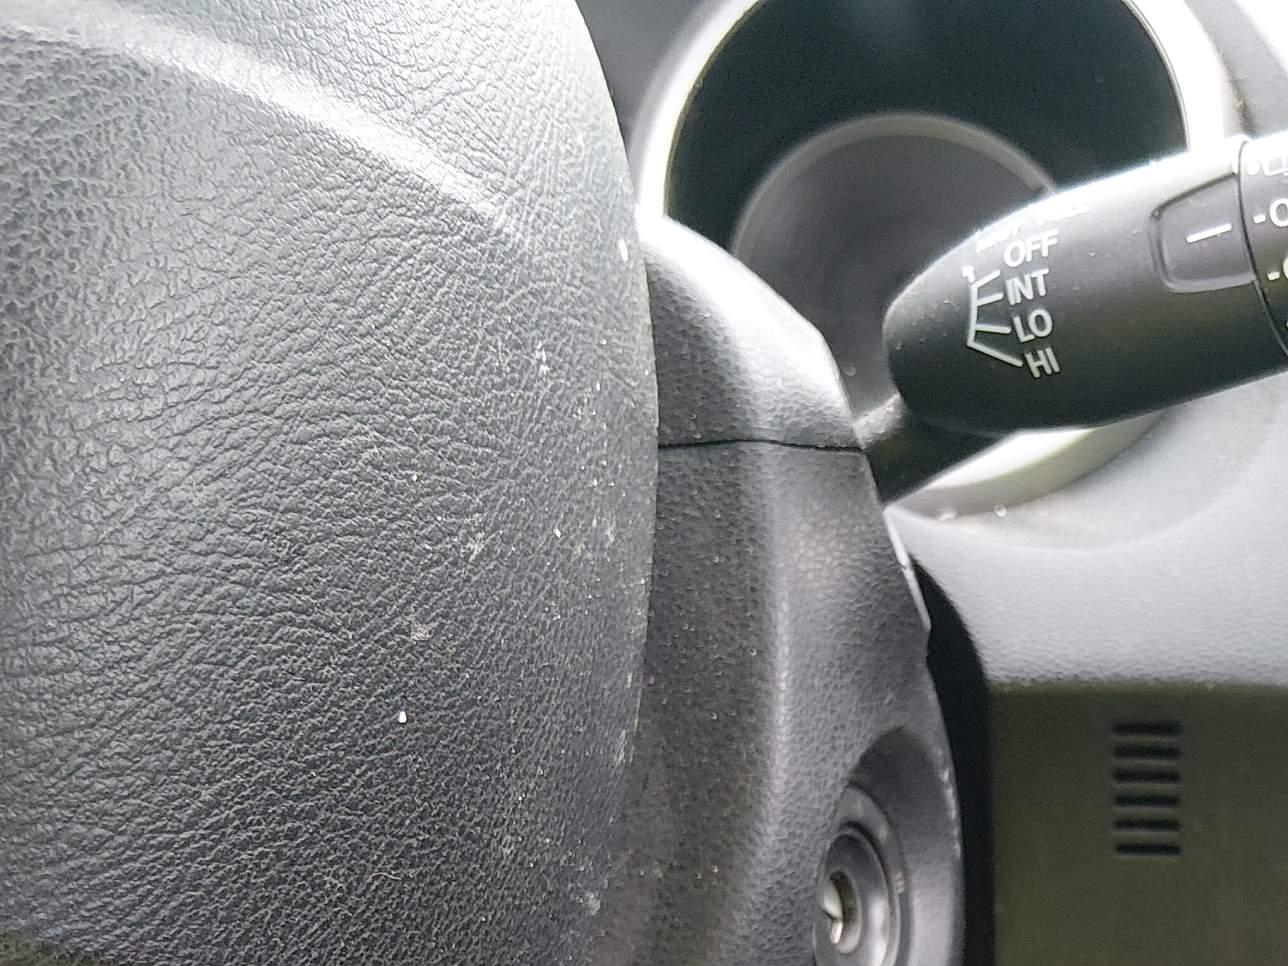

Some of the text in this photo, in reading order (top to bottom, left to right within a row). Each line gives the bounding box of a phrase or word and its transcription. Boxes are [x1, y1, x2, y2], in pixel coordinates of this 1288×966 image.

[1003, 229, 1059, 268] OFF
[1005, 267, 1050, 306] INT
[1012, 308, 1054, 342] LO
[1024, 347, 1060, 378] HI
